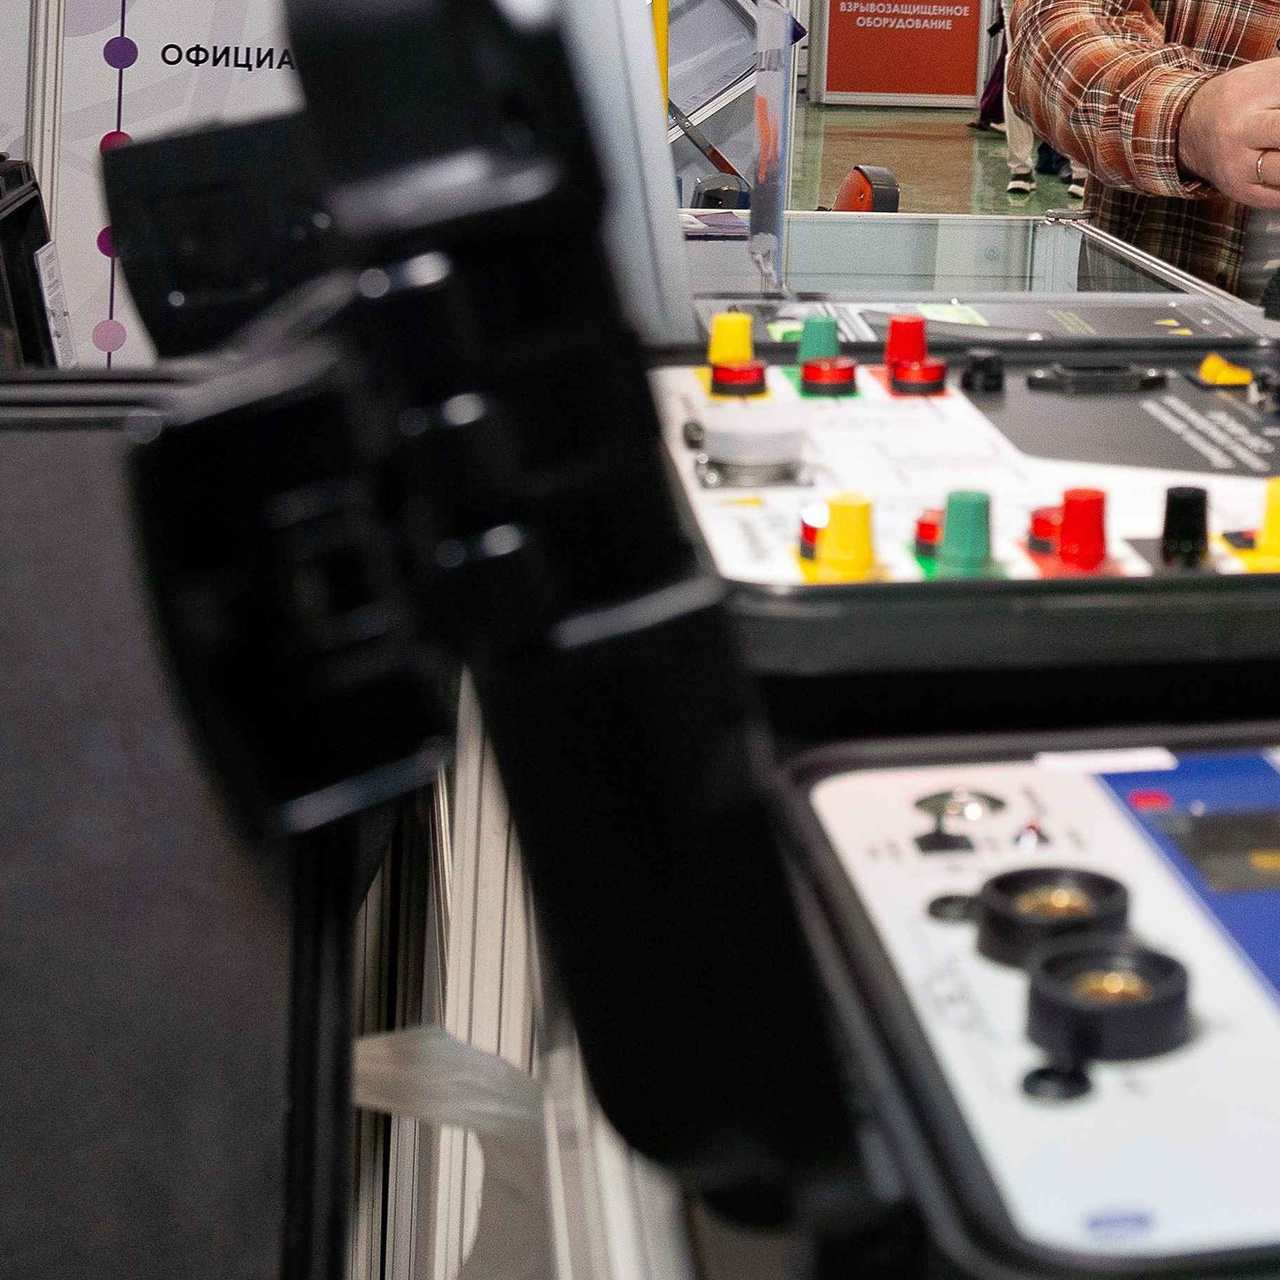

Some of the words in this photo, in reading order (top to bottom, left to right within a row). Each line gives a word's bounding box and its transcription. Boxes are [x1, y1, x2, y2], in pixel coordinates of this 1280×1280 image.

[840, 1, 970, 17] ВЗРЫВОЗАЩИЩЕННОЕ
[856, 16, 953, 30] ОБОРУДОВАНИЕ
[161, 43, 295, 72] ОФИЦИА
